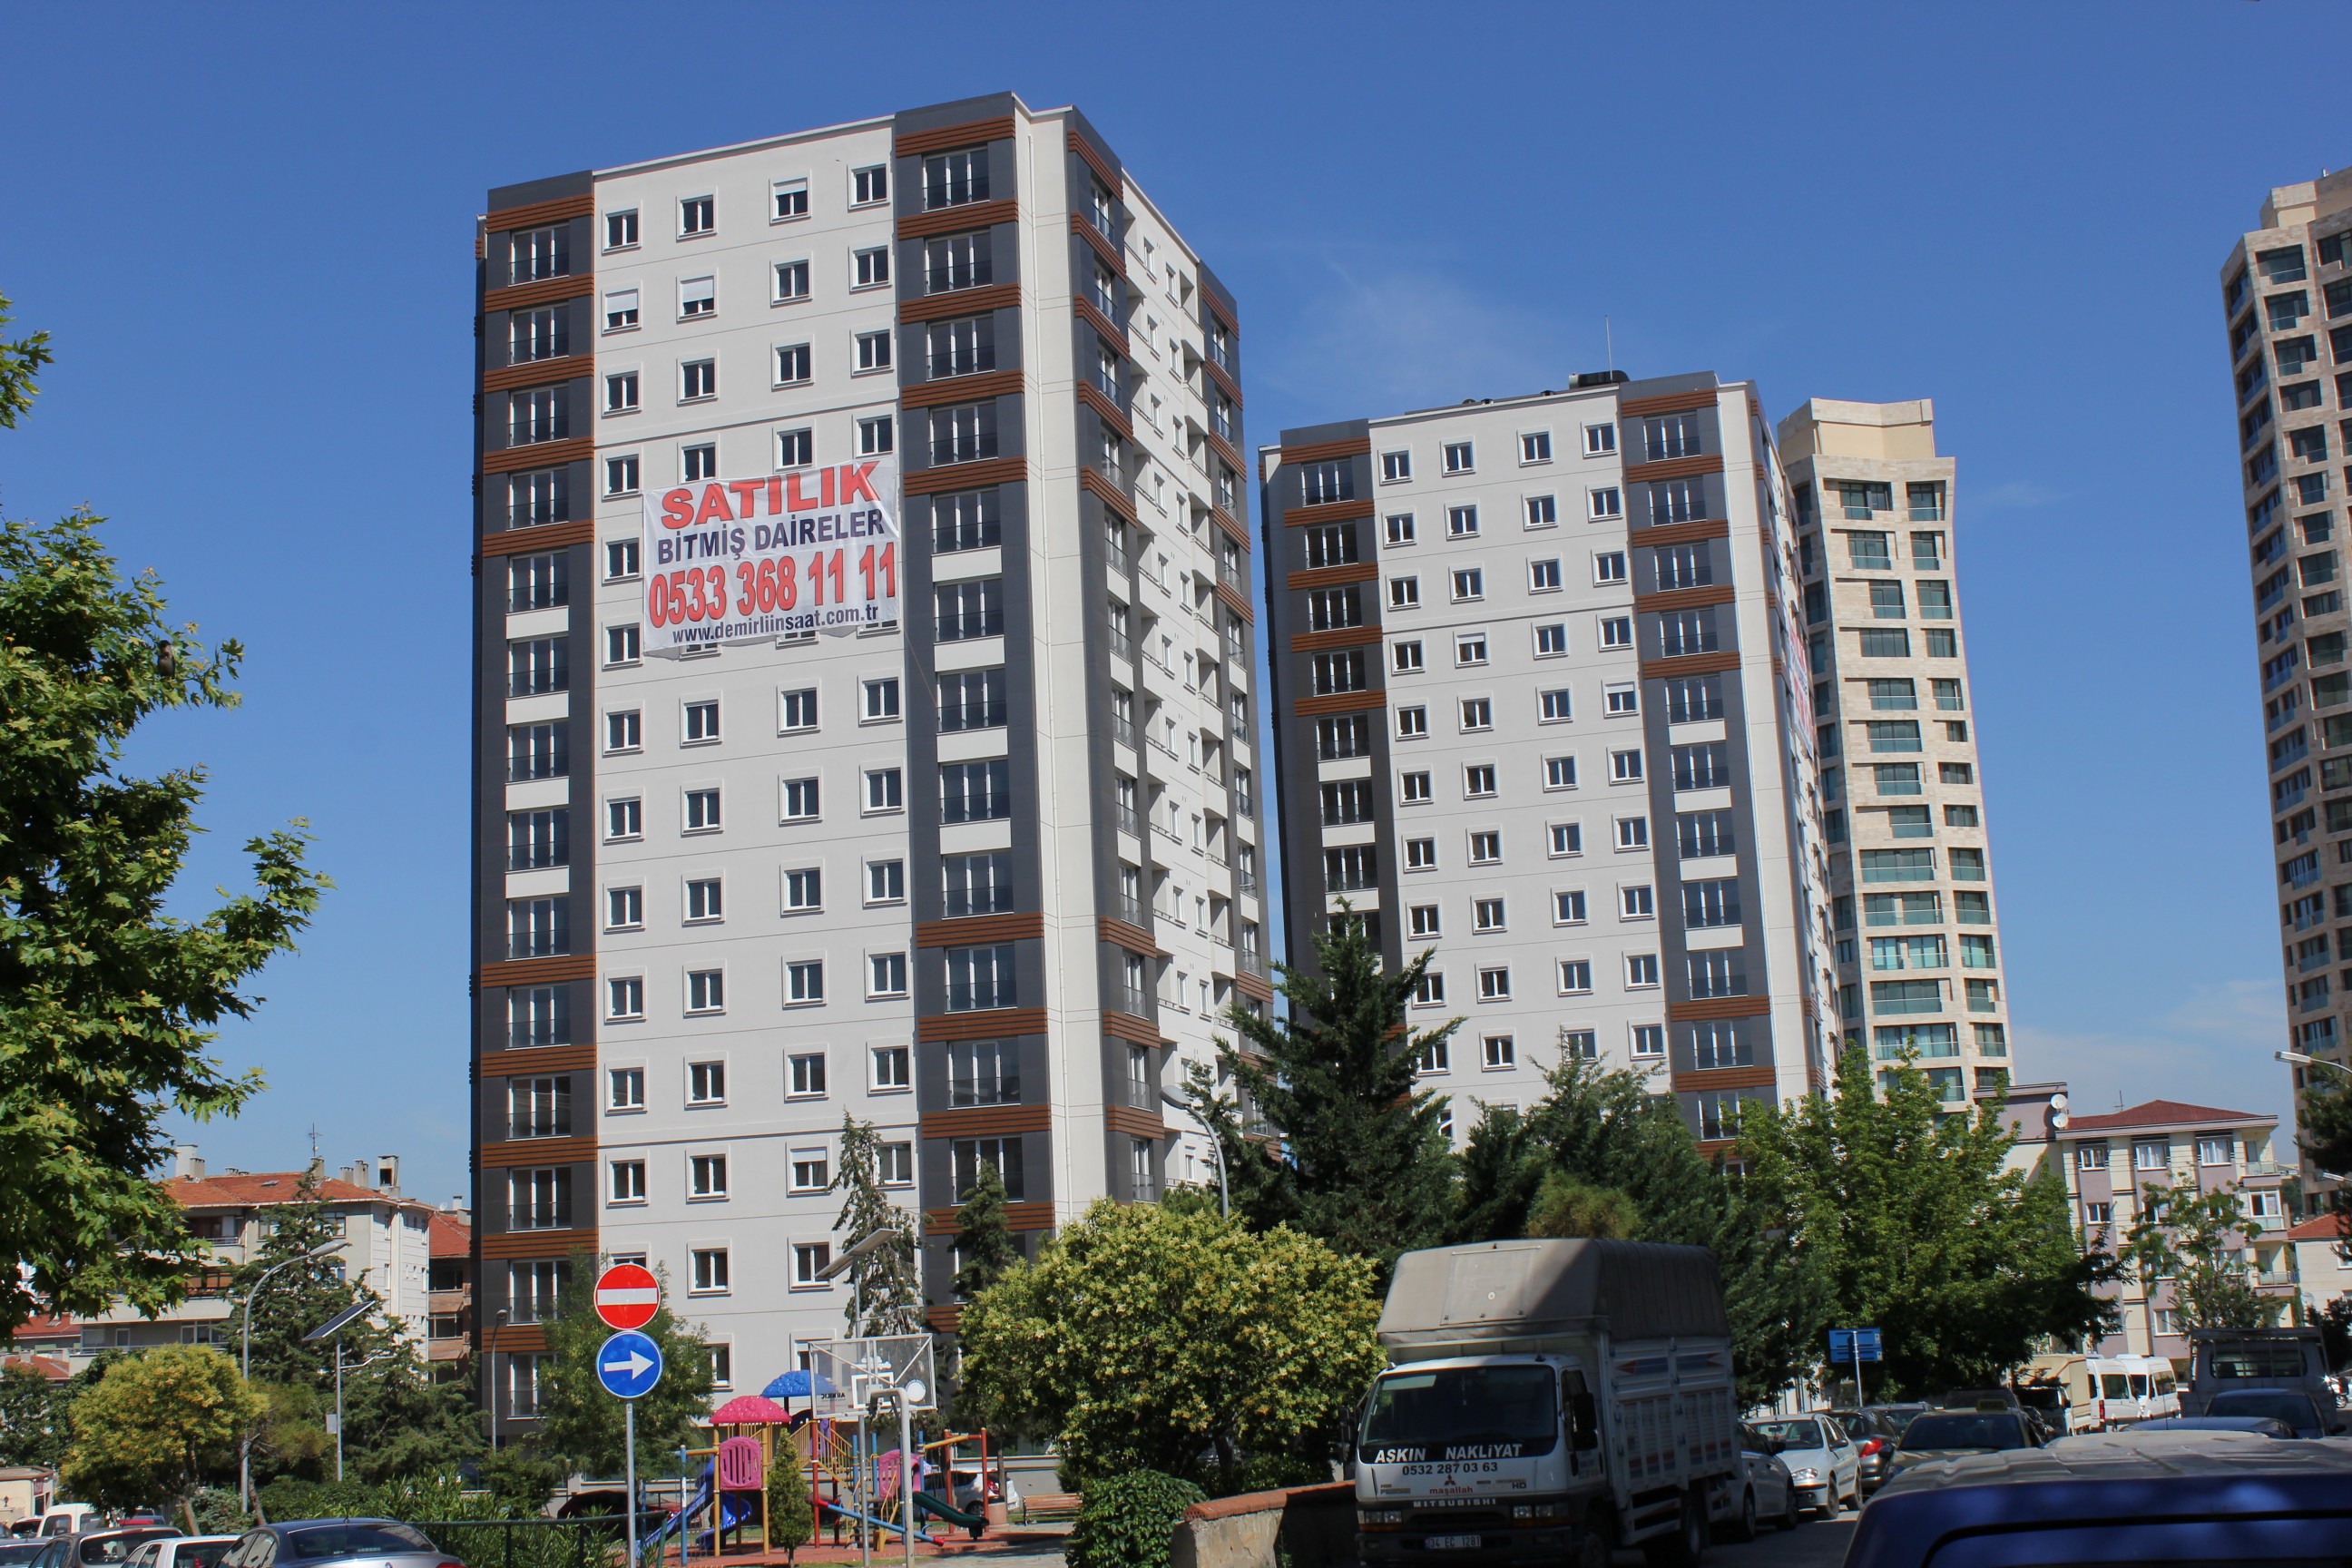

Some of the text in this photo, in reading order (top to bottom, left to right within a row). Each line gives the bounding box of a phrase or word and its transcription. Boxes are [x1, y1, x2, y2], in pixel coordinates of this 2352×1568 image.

[661, 461, 881, 529] SATILIK
[658, 508, 885, 564] BİTMİŞ DAİRELER
[649, 542, 896, 628] 0533 368 11 11
[672, 604, 879, 643] www.demirliinsaat.com.tr
[1375, 1448, 1426, 1464] AŞKIN
[1402, 1462, 1498, 1475] 0532 287 03 63
[1429, 1485, 1474, 1495] maşallah
[1413, 1498, 1496, 1508] MITSUBISHI
[1430, 1537, 1440, 1548] 34
